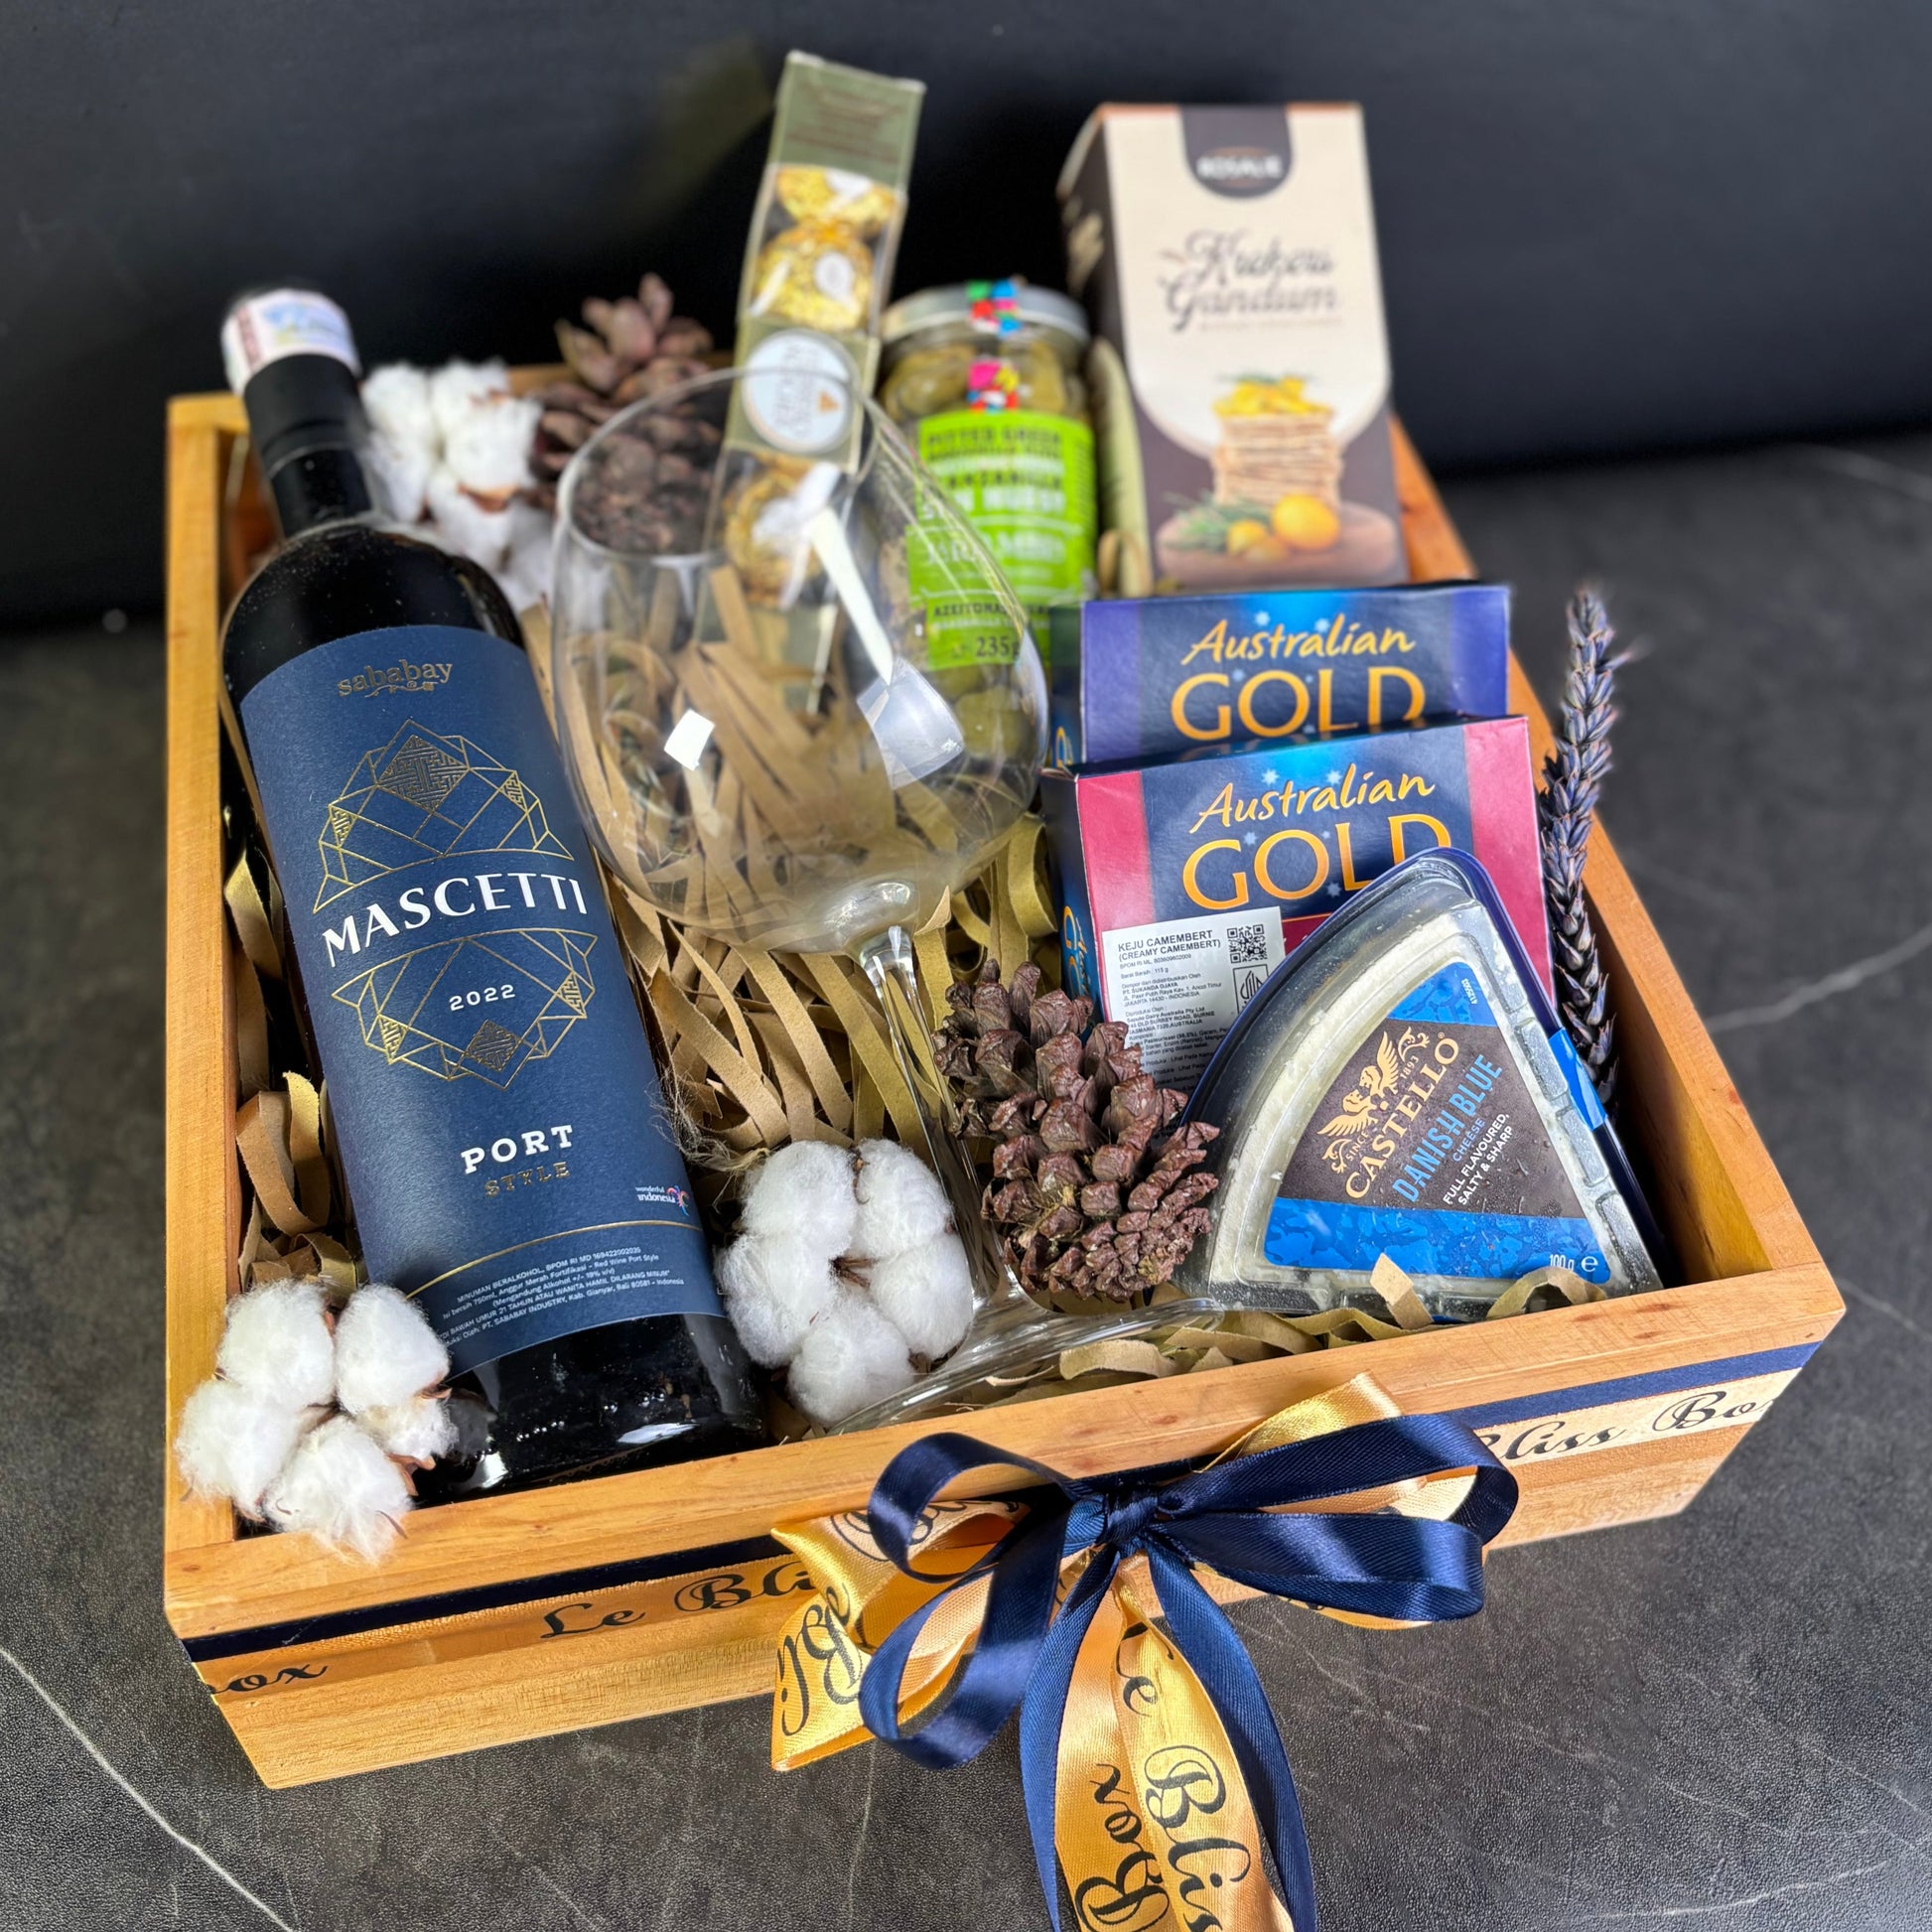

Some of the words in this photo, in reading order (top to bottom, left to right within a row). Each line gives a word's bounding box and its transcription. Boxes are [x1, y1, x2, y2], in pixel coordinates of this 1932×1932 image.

[1180, 614, 1416, 666] Australian
[338, 658, 453, 697] sababay
[1172, 666, 1426, 741] GOLD
[1189, 762, 1436, 834] Australian
[322, 873, 588, 968] MASCETTI
[1118, 940, 1144, 952] KEJU
[1146, 929, 1213, 947] CAMEMBERT
[1119, 948, 1159, 962] (CREAMY
[1160, 939, 1221, 954] CAMEMBERT)
[448, 984, 516, 1012] 2022
[1345, 1130, 1370, 1162] SINCE
[1400, 1055, 1420, 1079] 1893
[1345, 1036, 1459, 1199] CASTELLO
[1392, 1110, 1466, 1203] DANISH
[1448, 1054, 1502, 1118] BLUE
[460, 1125, 574, 1174] PORT
[1443, 1169, 1467, 1205] FULL
[1461, 1112, 1510, 1173] FLAVOURED,
[1452, 1116, 1486, 1163] CHEESE
[483, 1161, 571, 1197] STYLE
[1457, 1167, 1484, 1206] SALTY
[1479, 1160, 1490, 1172] &
[1486, 1125, 1515, 1163] SHARP
[1549, 1254, 1566, 1269] 100
[457, 1285, 491, 1303] MINUMAN
[540, 1601, 645, 1639] Le
[674, 1560, 817, 1613] Bli
[207, 1663, 329, 1696] ox
